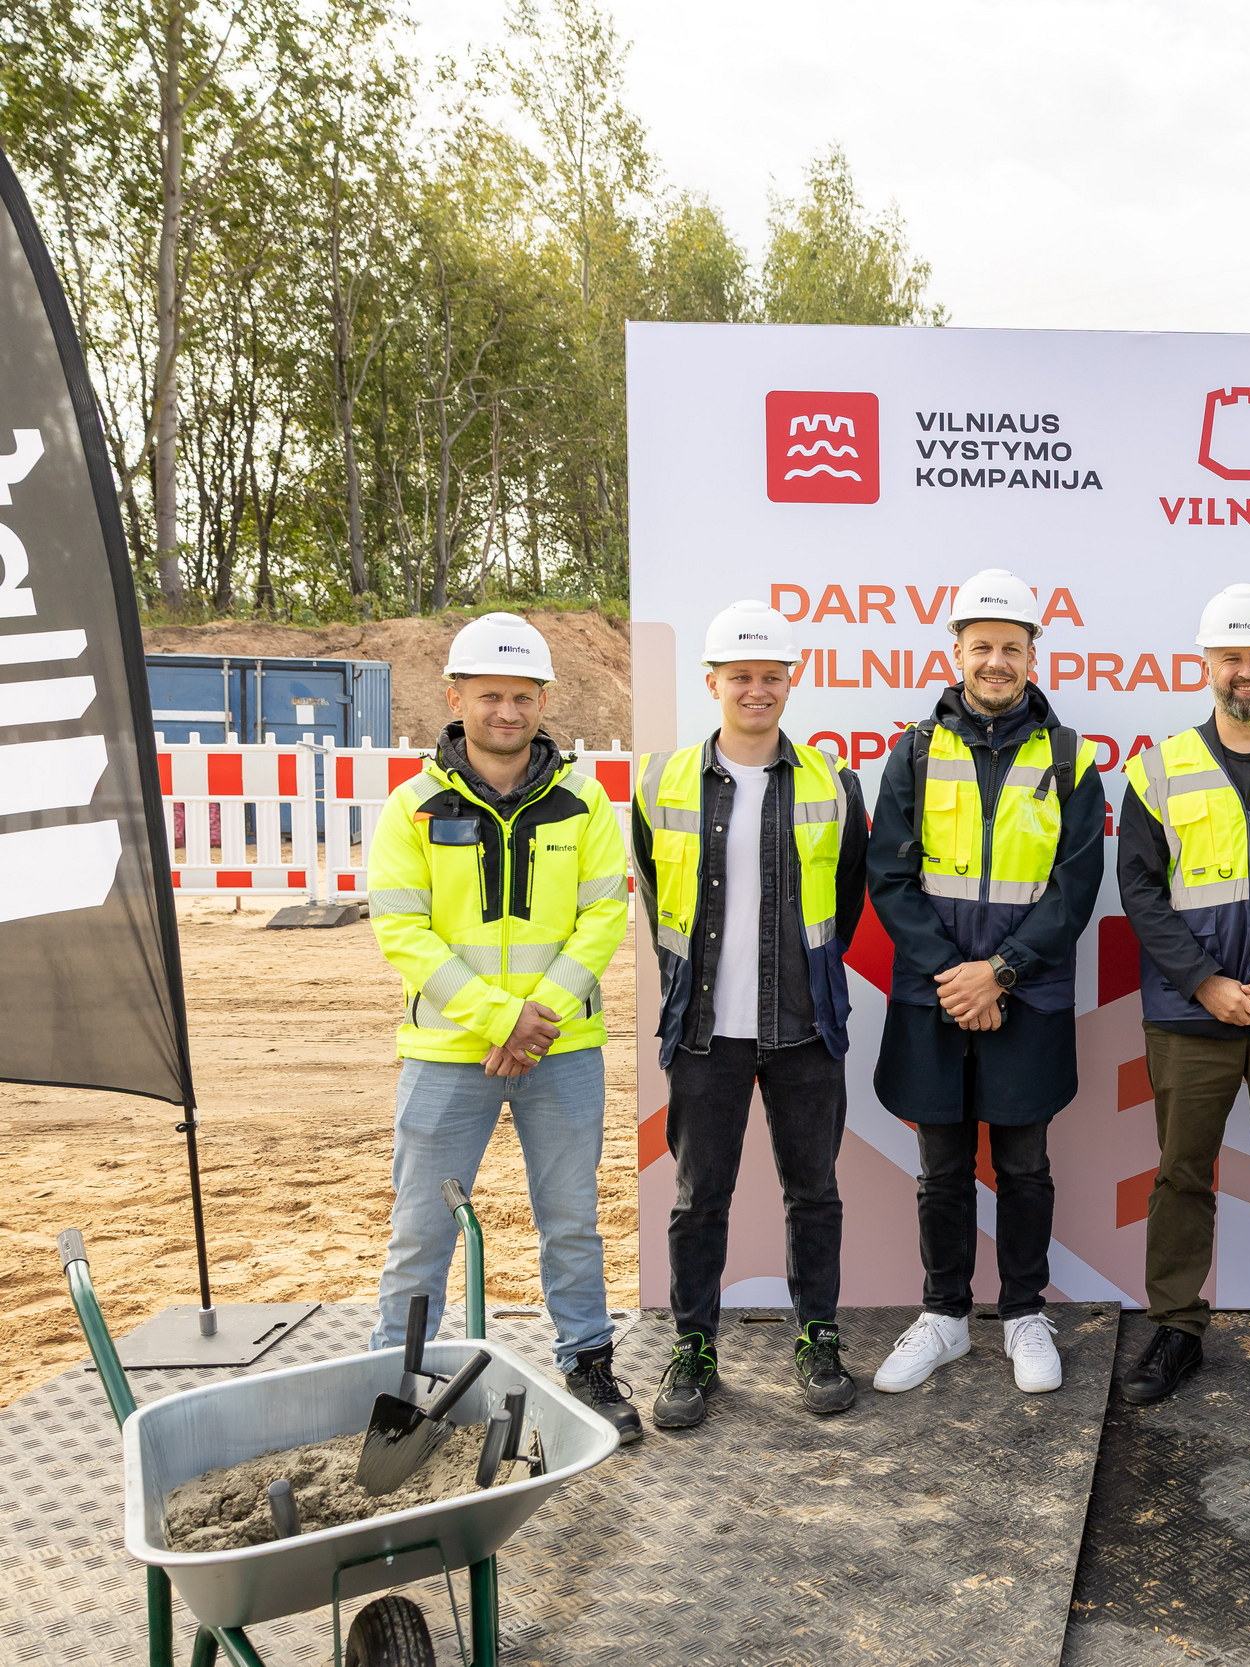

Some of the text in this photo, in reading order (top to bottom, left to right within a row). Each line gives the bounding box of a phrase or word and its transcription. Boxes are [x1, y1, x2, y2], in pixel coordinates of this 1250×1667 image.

[915, 411, 1060, 435] VILNIAUS
[915, 439, 1073, 462] VYSTYMO
[916, 467, 1104, 491] KOMPANIJA
[770, 583, 1085, 627] DAR VIA
[789, 648, 1039, 691] VILNIA
